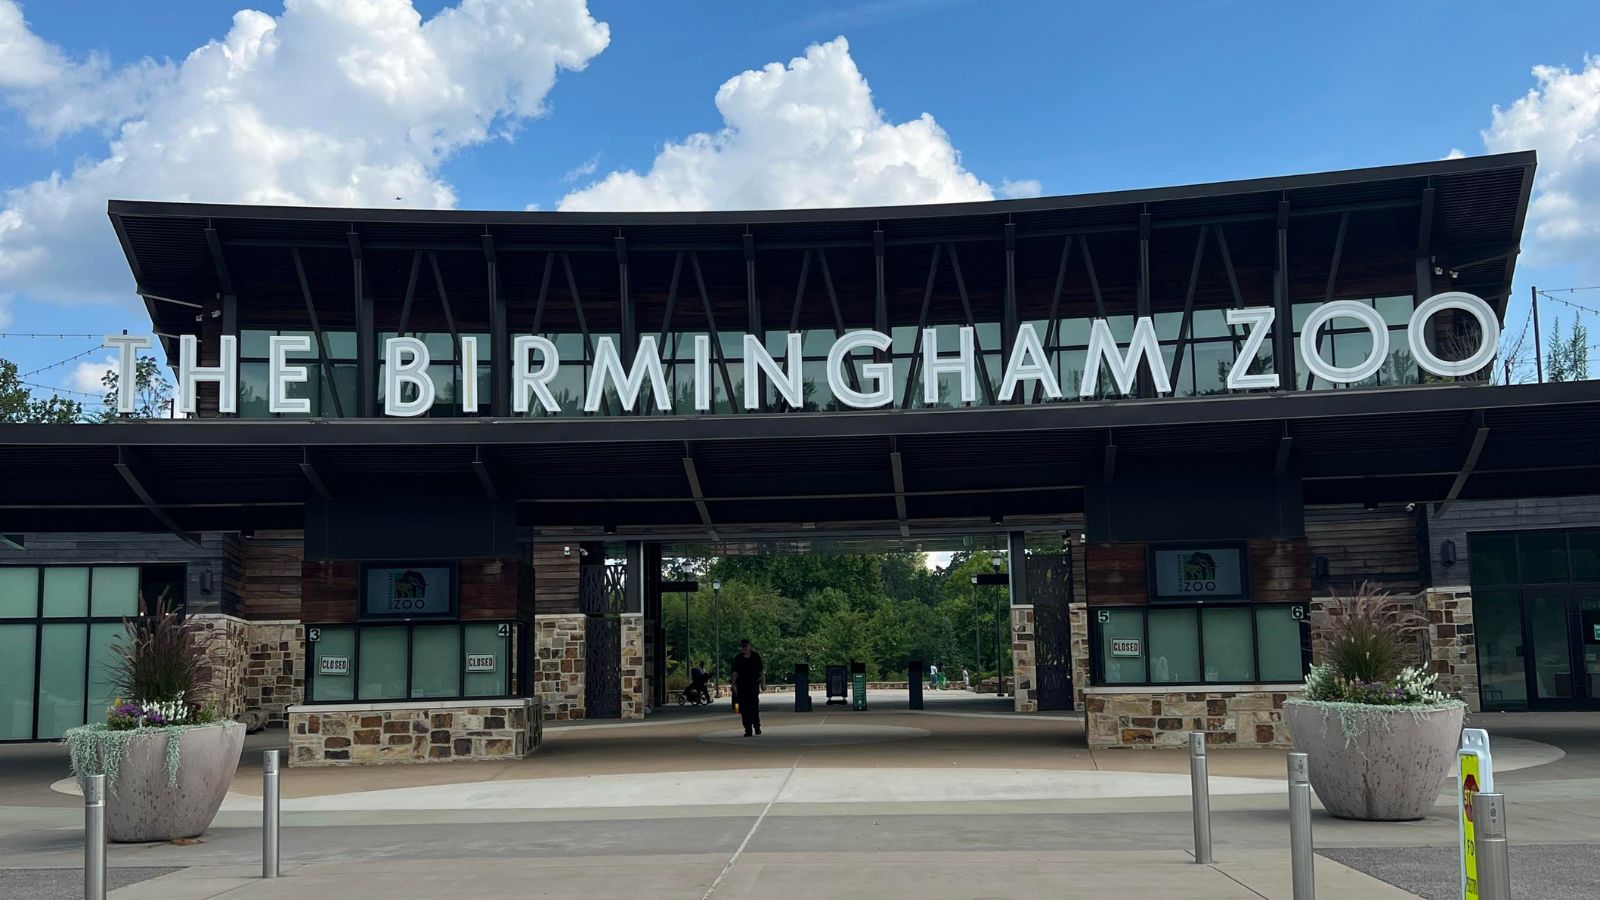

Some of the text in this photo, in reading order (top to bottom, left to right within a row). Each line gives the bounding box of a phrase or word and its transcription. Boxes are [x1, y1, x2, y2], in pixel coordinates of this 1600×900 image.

[103, 291, 1500, 417] THE BIRMINGHAM ZOO
[1184, 581, 1216, 592] ZOO
[394, 599, 425, 610] ZOO
[1099, 611, 1109, 622] 5
[1292, 606, 1303, 618] 6
[310, 629, 320, 641] 3
[499, 624, 508, 636] 4
[1113, 642, 1138, 652] CLOSED
[322, 660, 347, 670] CLOSED
[469, 657, 493, 667] CLOSED
